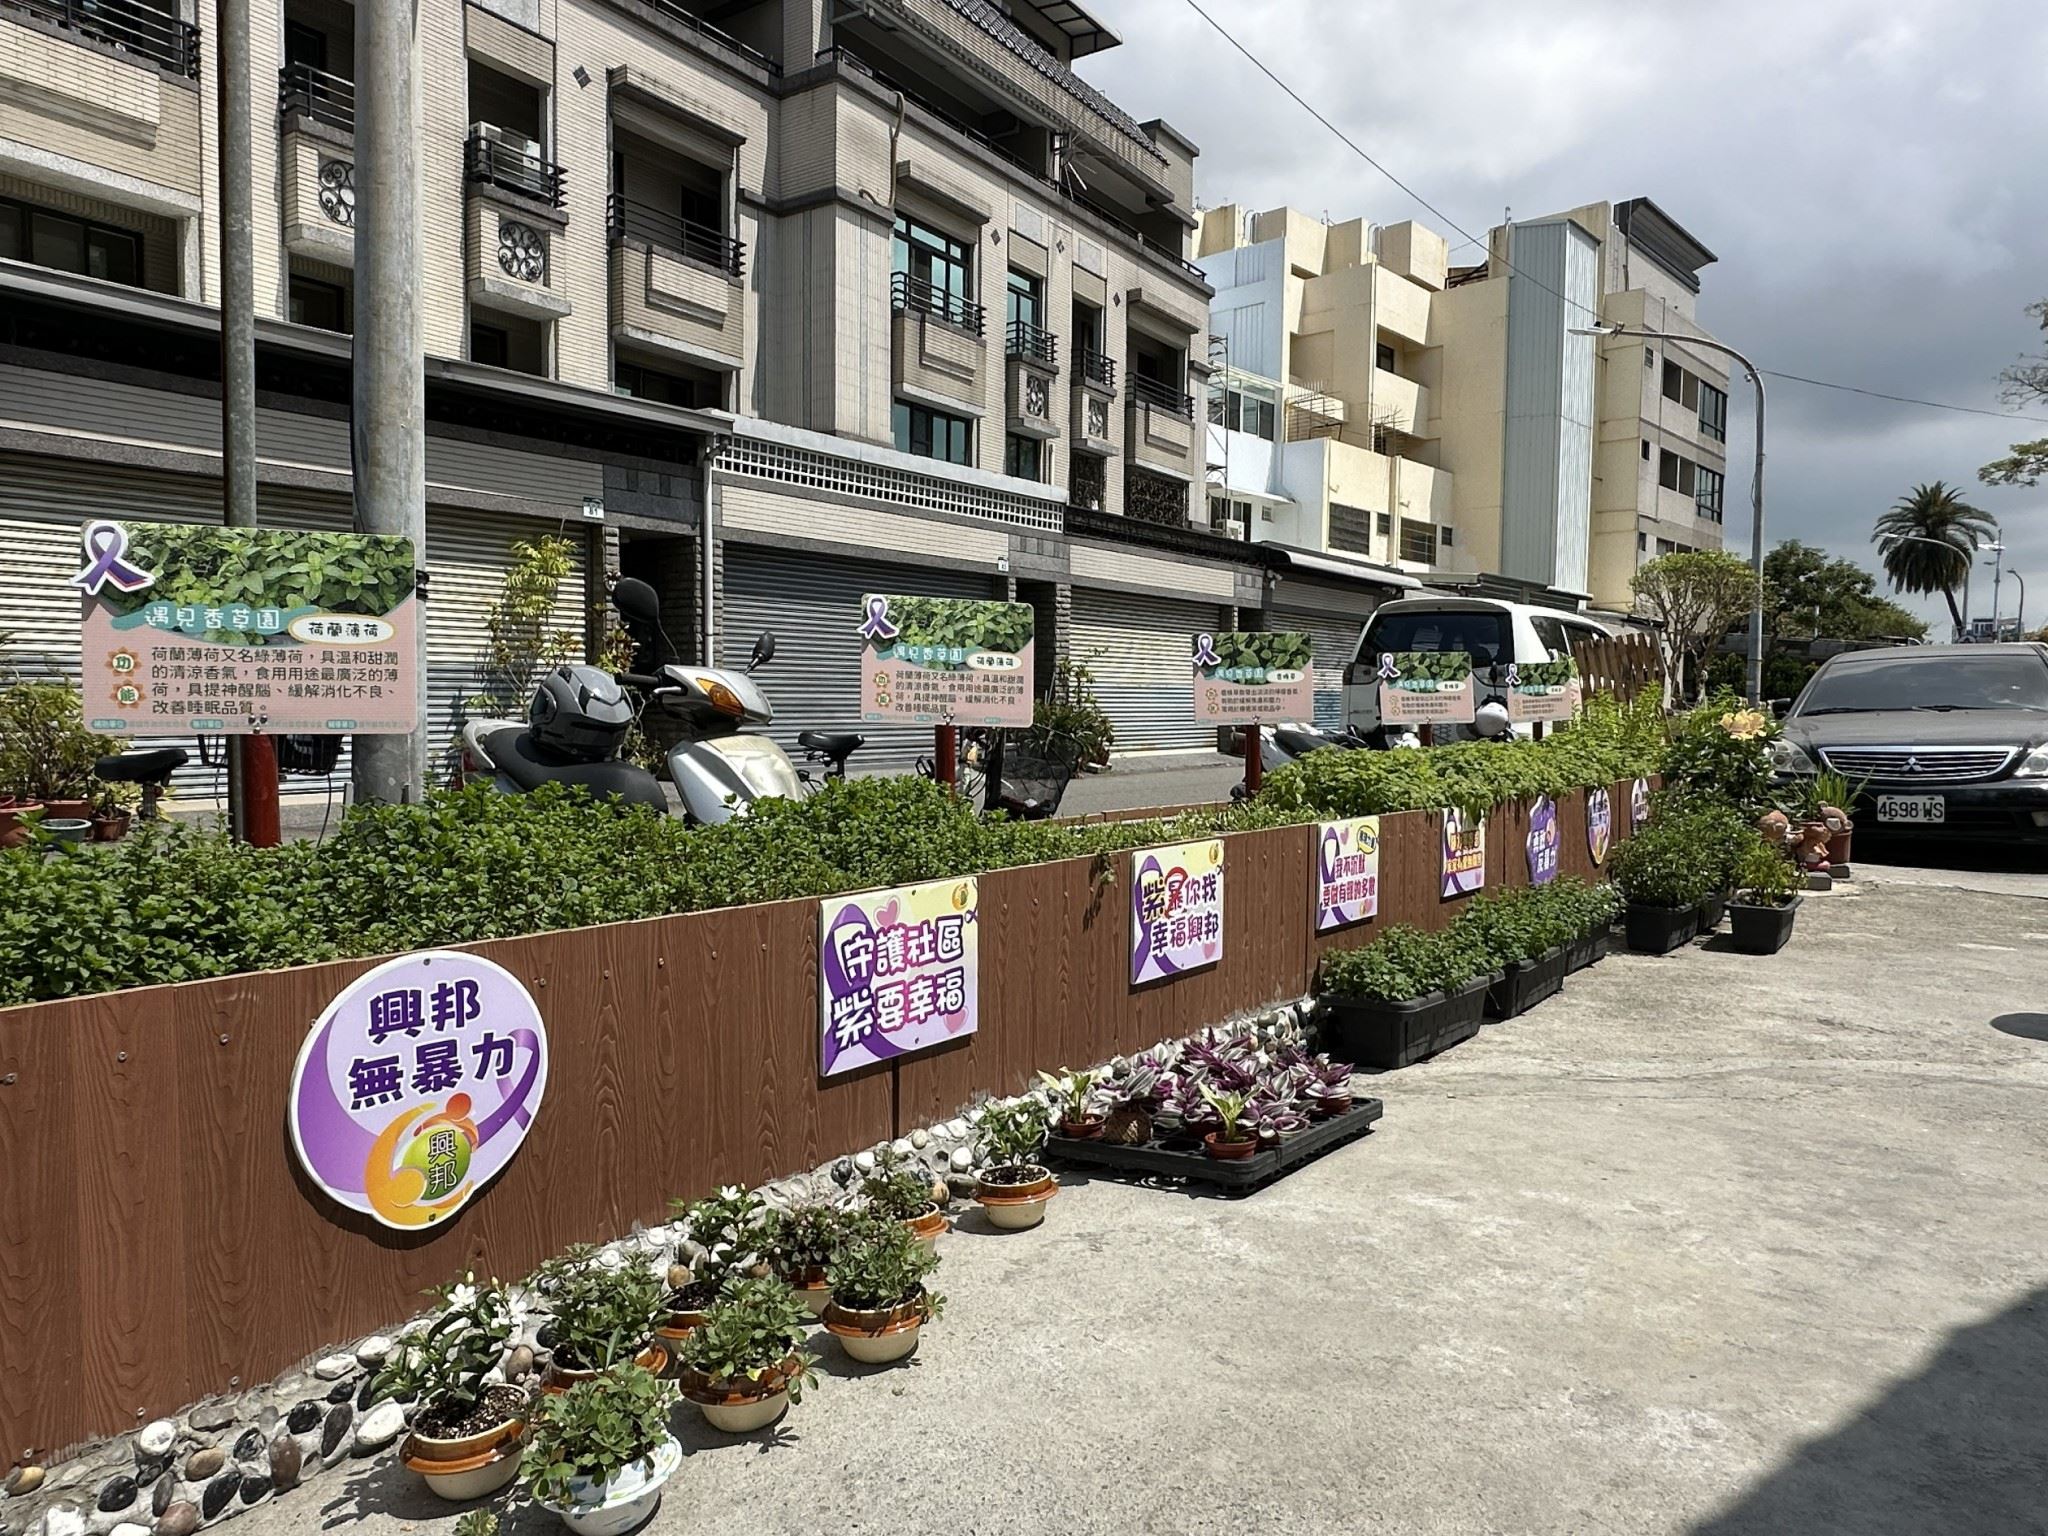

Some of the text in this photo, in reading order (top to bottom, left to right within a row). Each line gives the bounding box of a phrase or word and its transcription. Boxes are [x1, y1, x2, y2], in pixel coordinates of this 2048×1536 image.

[144, 606, 280, 629] 遇見香草園
[308, 621, 380, 638] 荷蘭薄荷
[843, 916, 964, 980] 守護社區
[1152, 910, 1219, 954] 幸福興邦
[368, 979, 481, 1044] 興邦
[833, 968, 964, 1048] 紫要幸福
[348, 1032, 515, 1110] 無暴力
[428, 1130, 458, 1194] 興邦
